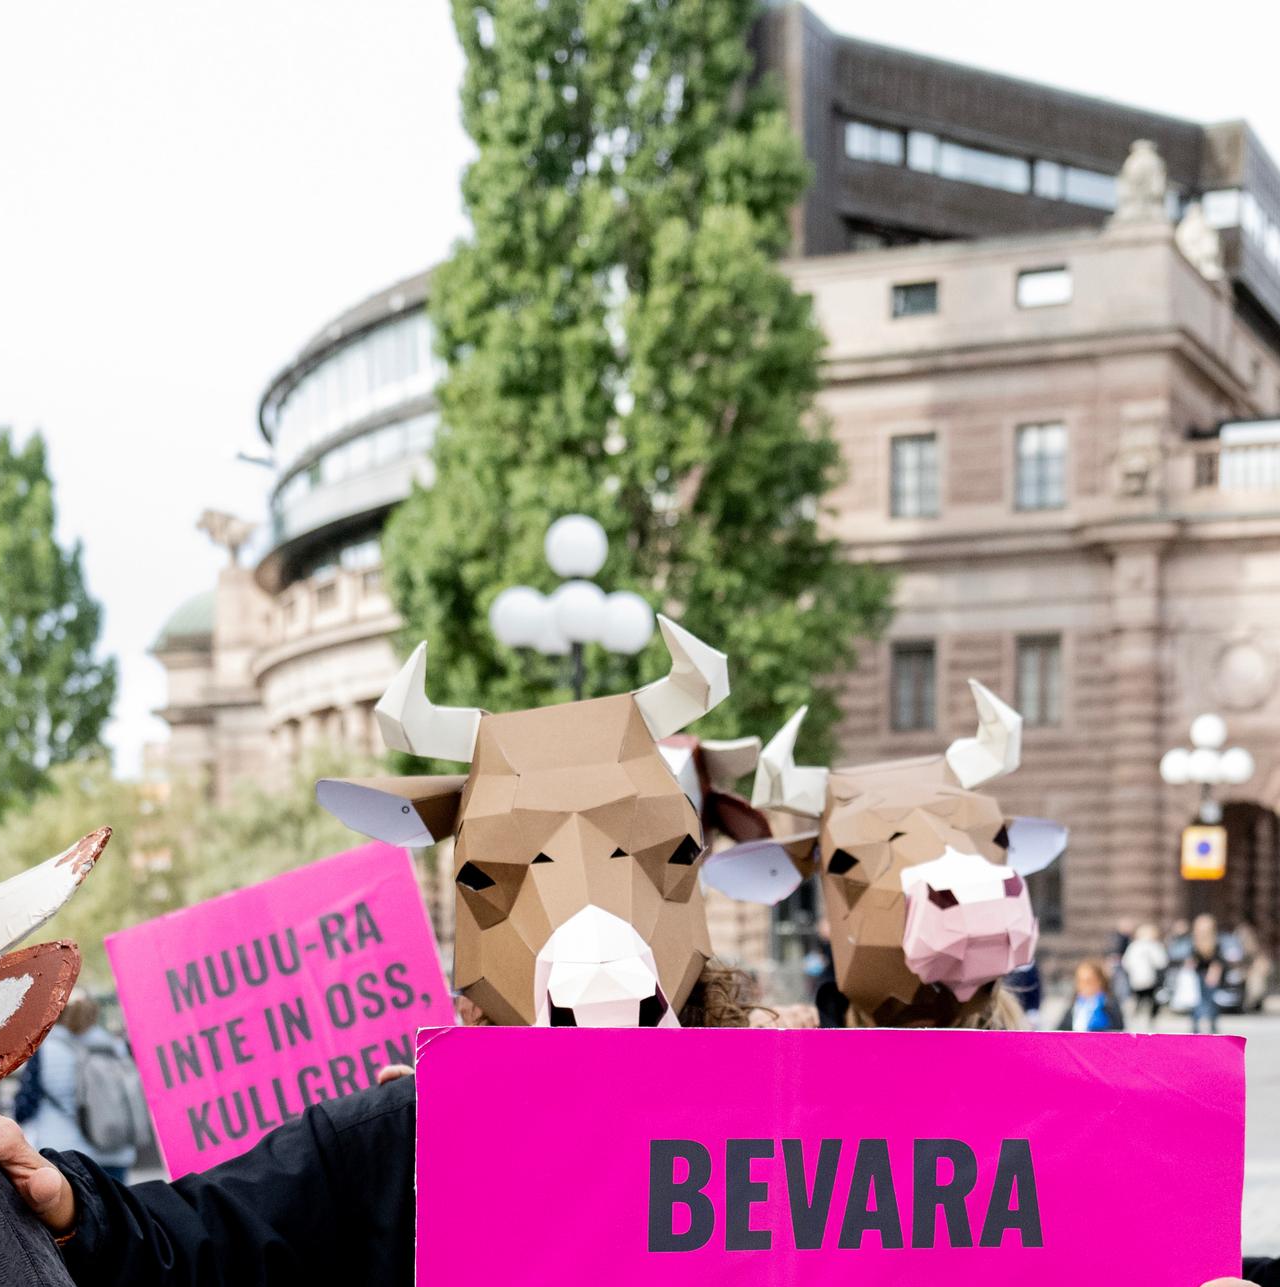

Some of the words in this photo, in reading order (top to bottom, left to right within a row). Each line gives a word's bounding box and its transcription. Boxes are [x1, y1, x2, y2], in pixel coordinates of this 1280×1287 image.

[166, 902, 384, 1013] MUUU-RA
[155, 1017, 255, 1090] INTE
[264, 997, 314, 1052] IN
[325, 962, 432, 1030] OSS,
[647, 1137, 1044, 1253] BEVARA
